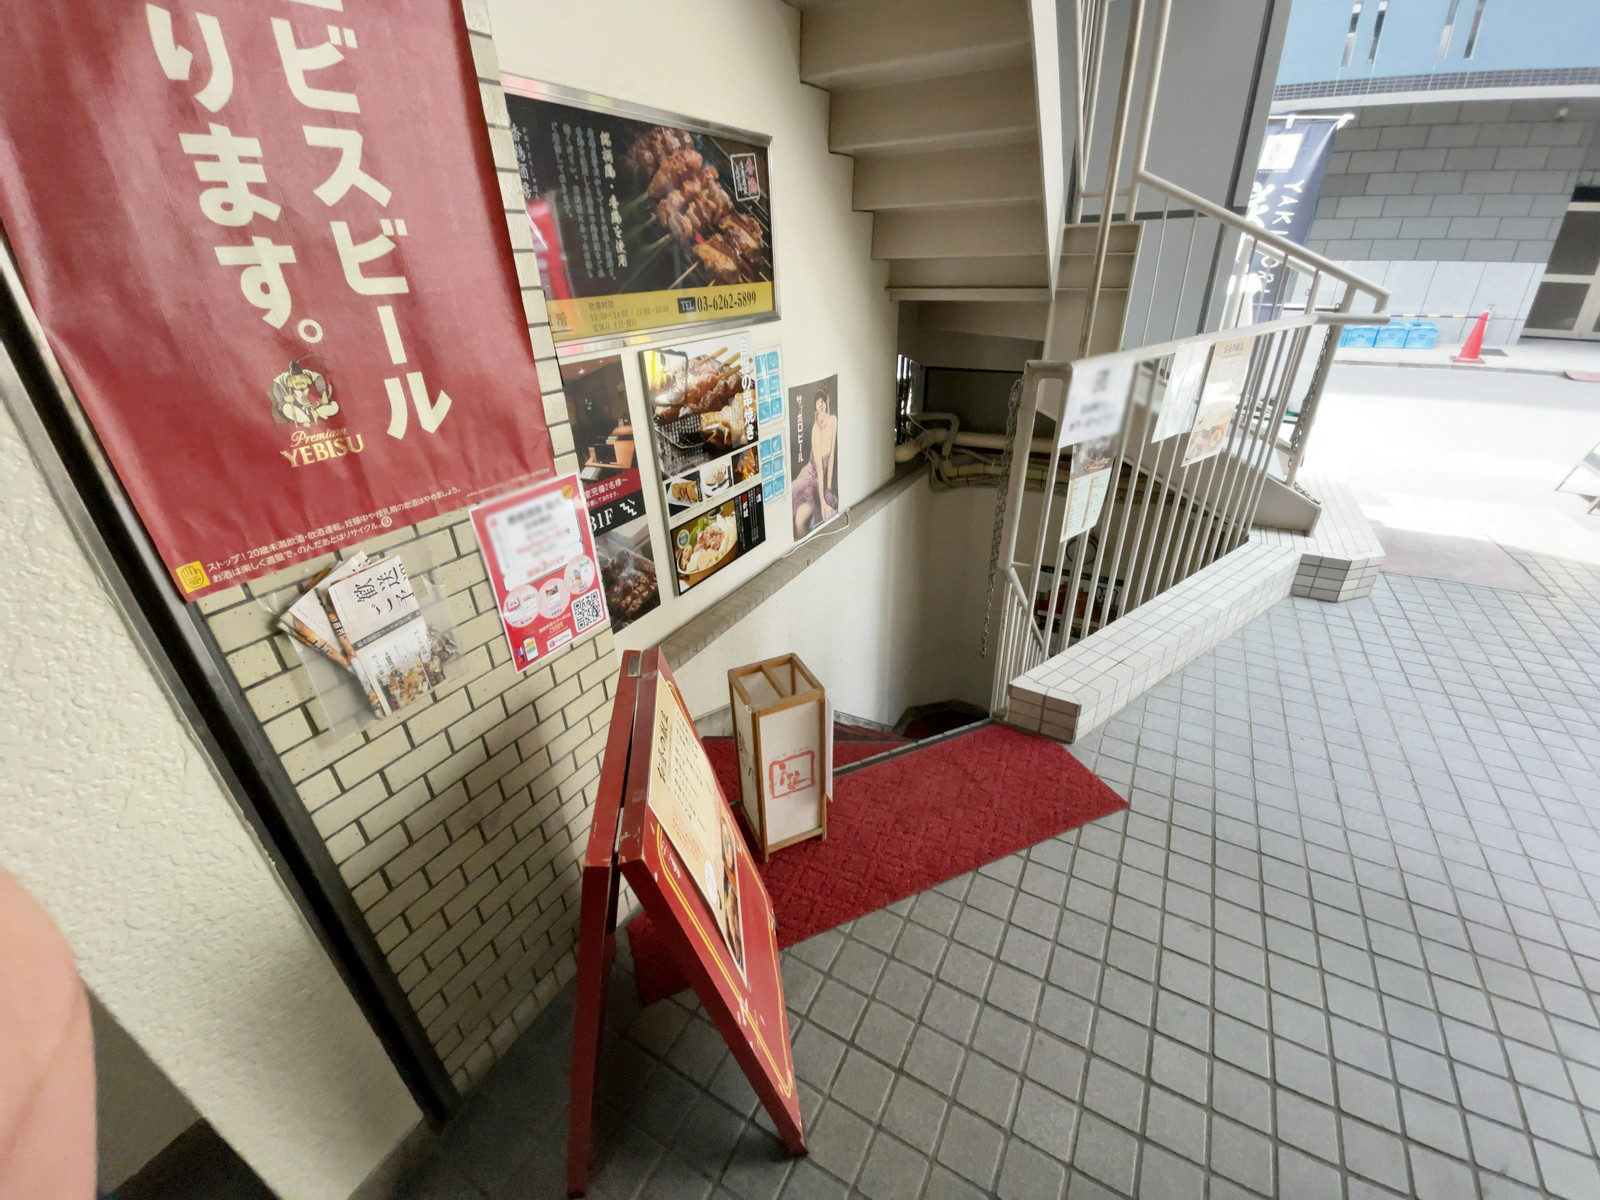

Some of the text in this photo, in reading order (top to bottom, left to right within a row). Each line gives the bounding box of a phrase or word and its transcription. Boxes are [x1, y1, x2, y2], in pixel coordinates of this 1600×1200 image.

[270, 0, 452, 441] ビスビール
[1257, 179, 1305, 293] YAKIORI
[681, 291, 757, 312] TEL 03-6262-5899
[281, 433, 364, 467] YEBISU
[290, 426, 349, 447] Premium
[353, 563, 408, 603] 歓送
